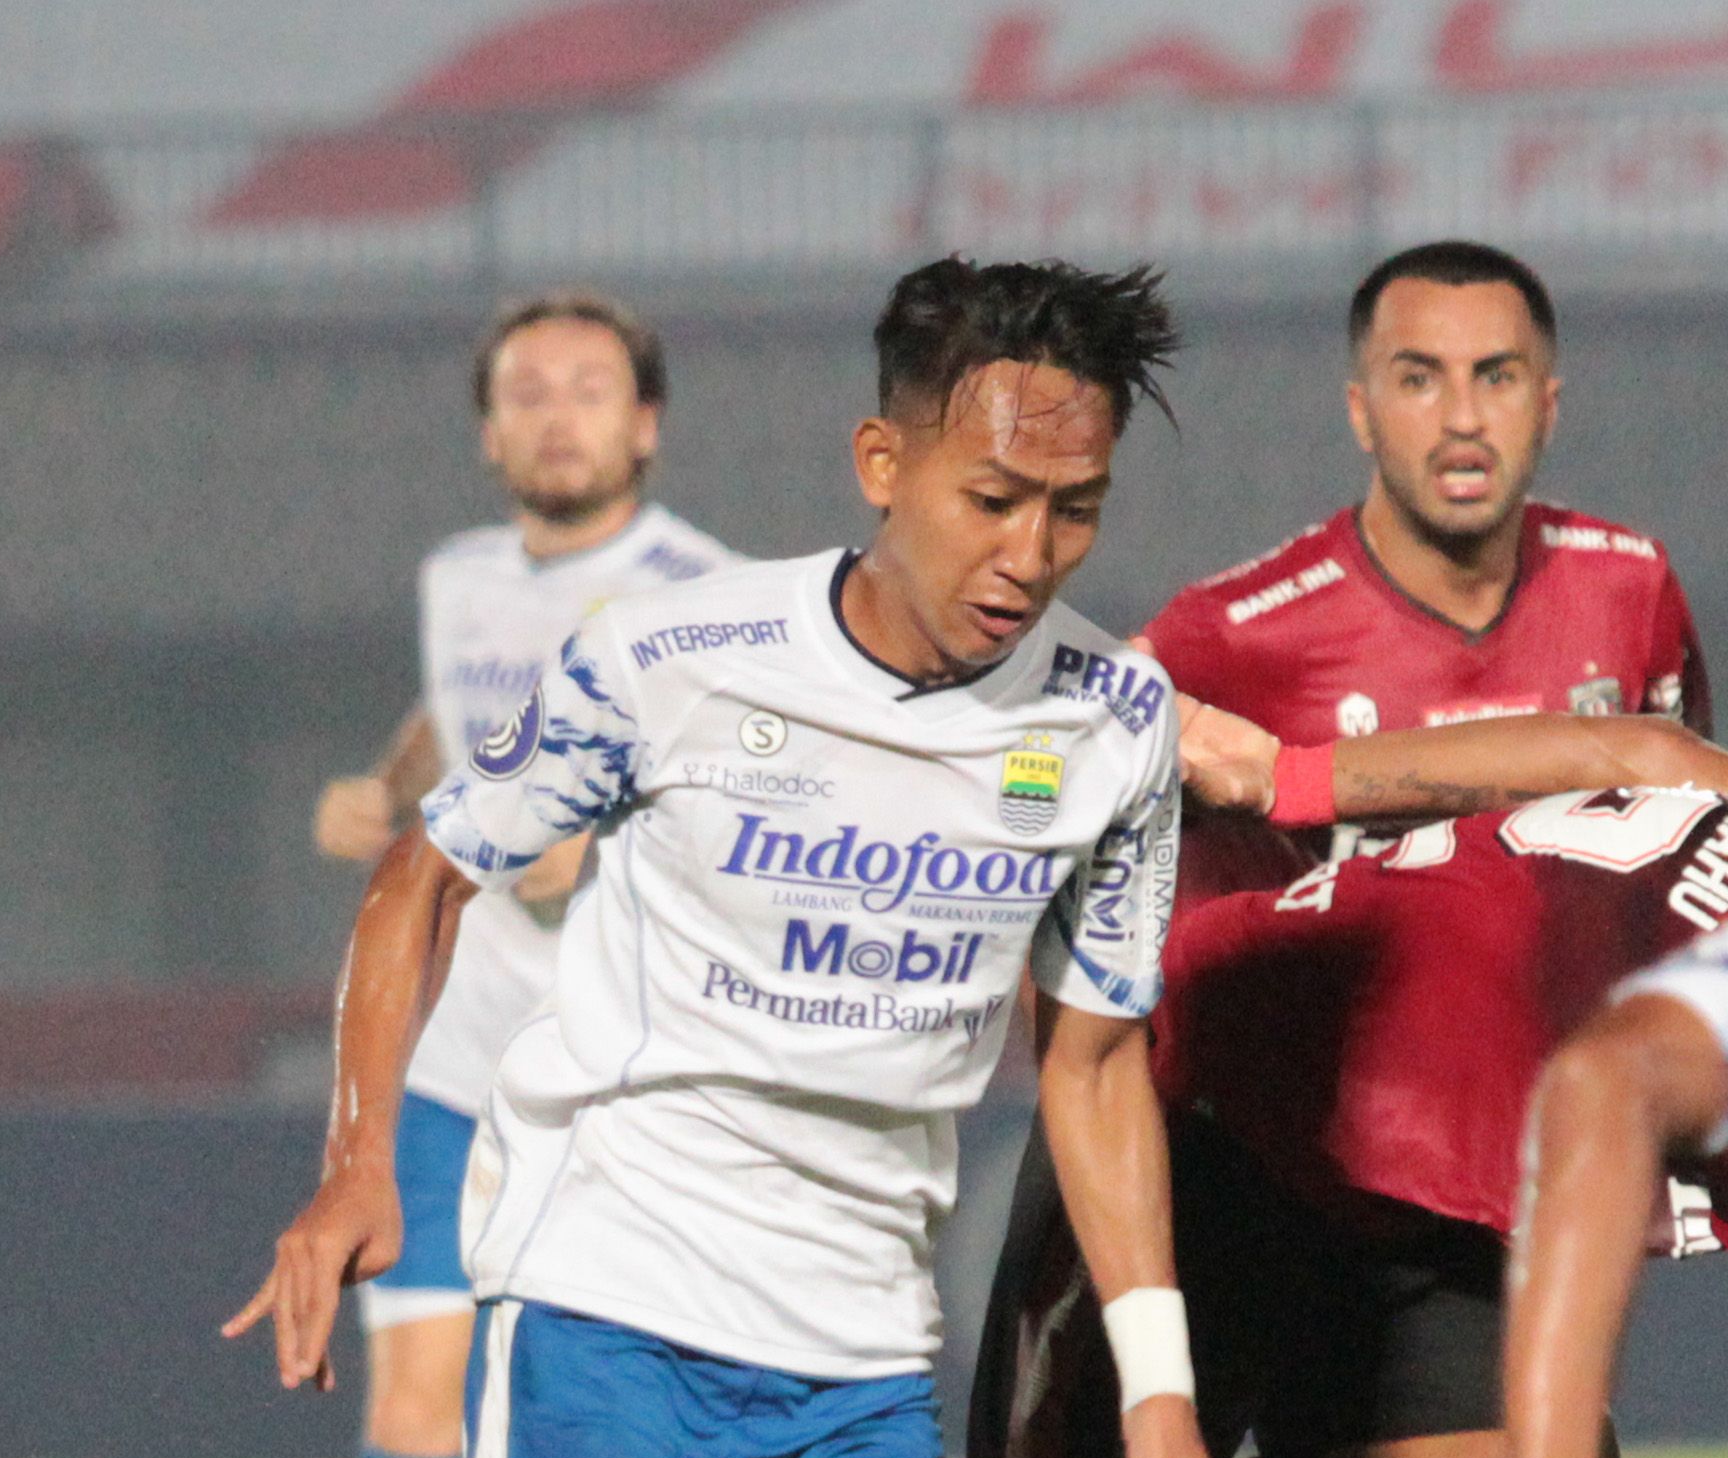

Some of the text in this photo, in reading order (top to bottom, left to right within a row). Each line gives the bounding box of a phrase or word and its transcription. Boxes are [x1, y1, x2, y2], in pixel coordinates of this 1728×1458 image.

[630, 618, 789, 671] INTERSPORT
[1046, 642, 1165, 726] PRIA
[723, 767, 835, 798] halodoc
[1010, 755, 1058, 773] PERSIB
[717, 812, 1056, 914] Indofood
[780, 919, 984, 985] Mobil
[702, 961, 954, 1033] PermataBank
